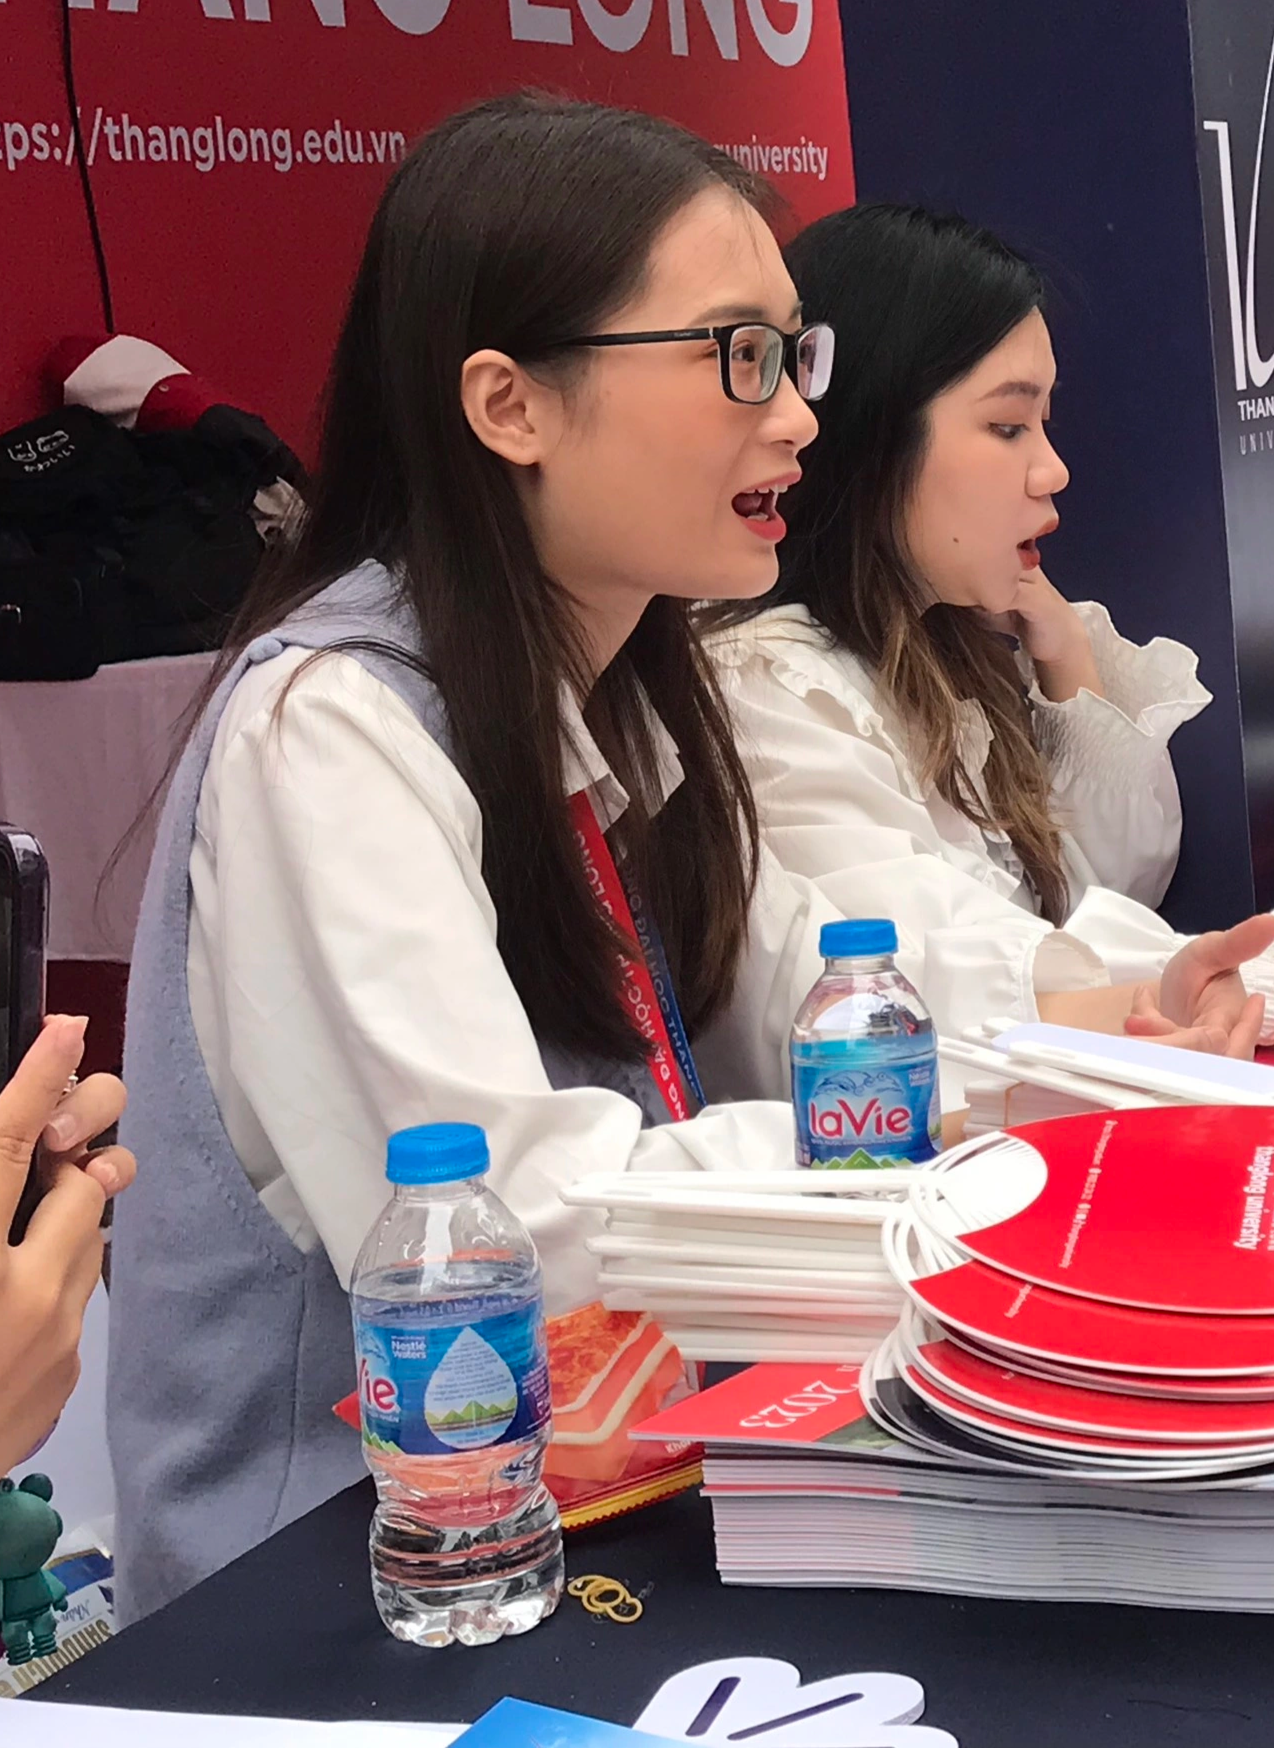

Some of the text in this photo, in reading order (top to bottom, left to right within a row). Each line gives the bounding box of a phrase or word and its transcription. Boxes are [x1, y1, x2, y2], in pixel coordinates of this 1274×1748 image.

[0, 107, 406, 172] ps://thanglong.edu.vn
[810, 1097, 911, 1138] laVie
[739, 1380, 860, 1428] 2023
